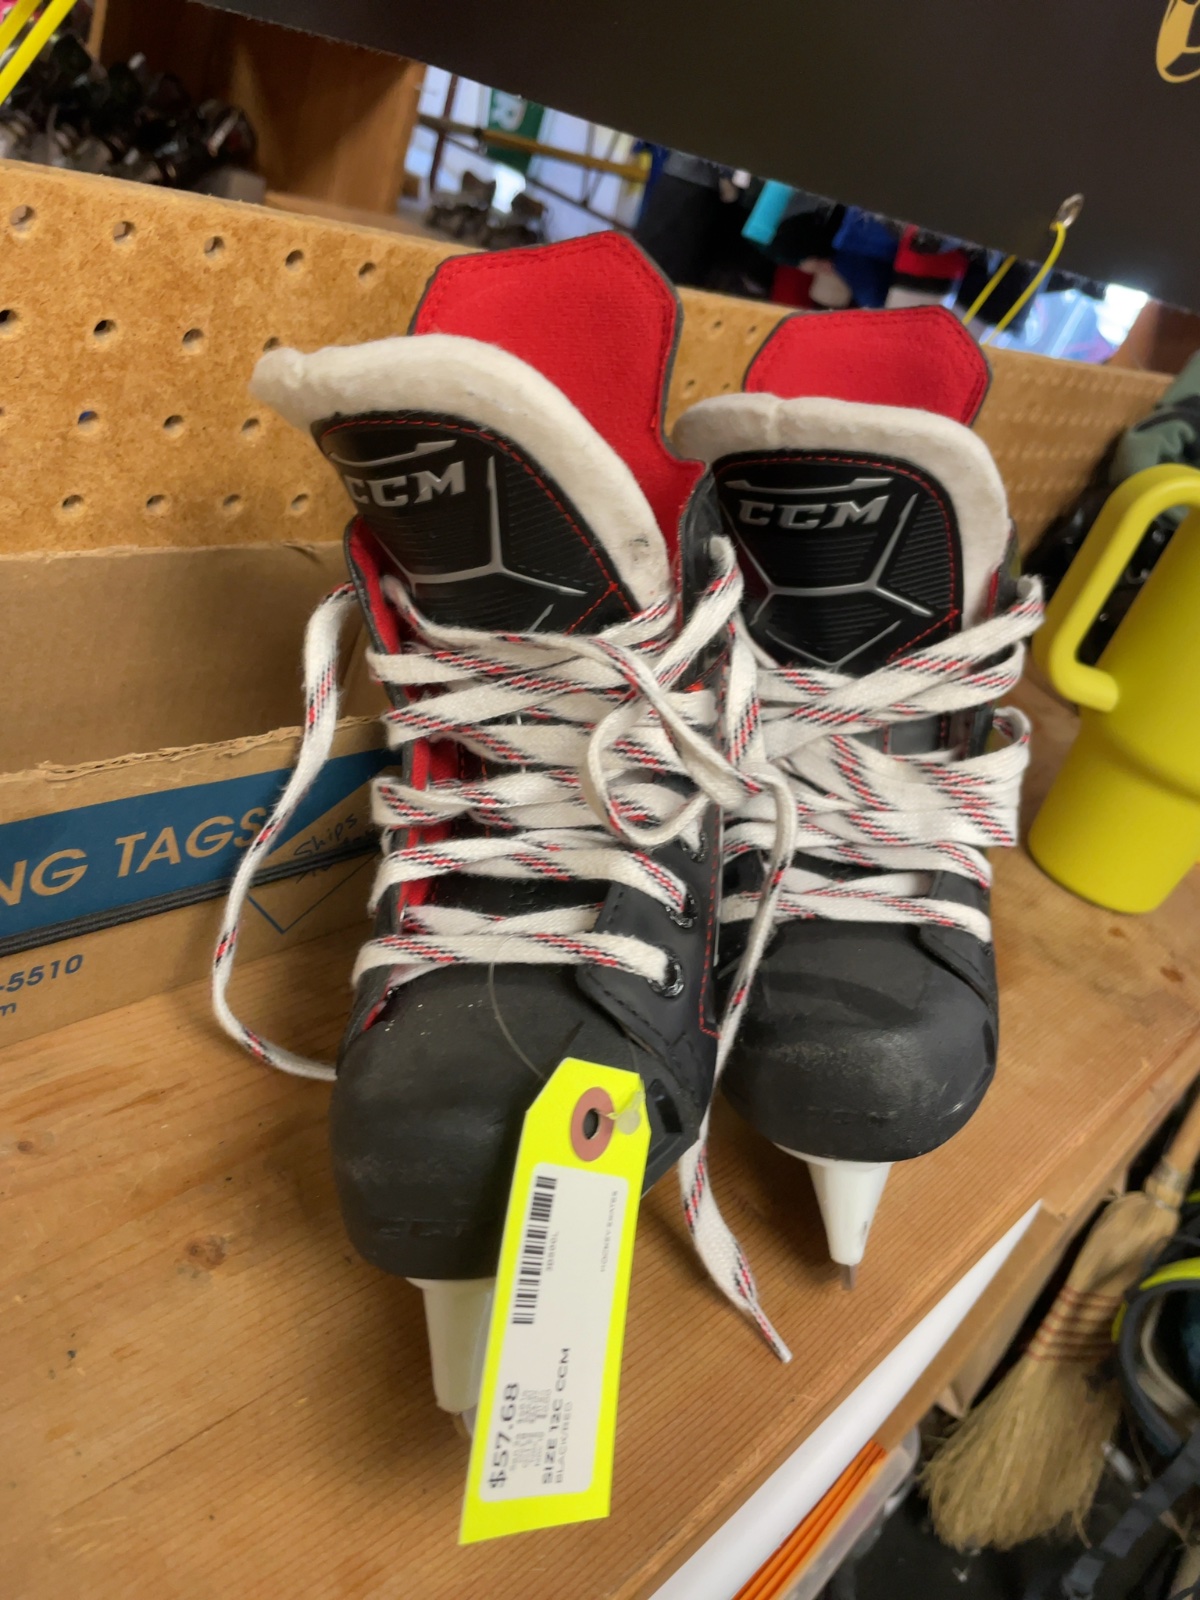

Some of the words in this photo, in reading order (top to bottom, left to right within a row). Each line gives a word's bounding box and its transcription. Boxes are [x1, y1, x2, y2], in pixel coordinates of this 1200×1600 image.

[344, 460, 466, 507] CCM
[739, 495, 889, 529] CCM
[115, 806, 267, 878] TAGS
[555, 1348, 571, 1392] CCM
[489, 1382, 519, 1488] $57.68
[549, 1399, 563, 1432] 12C
[542, 1438, 558, 1484] SIZE
